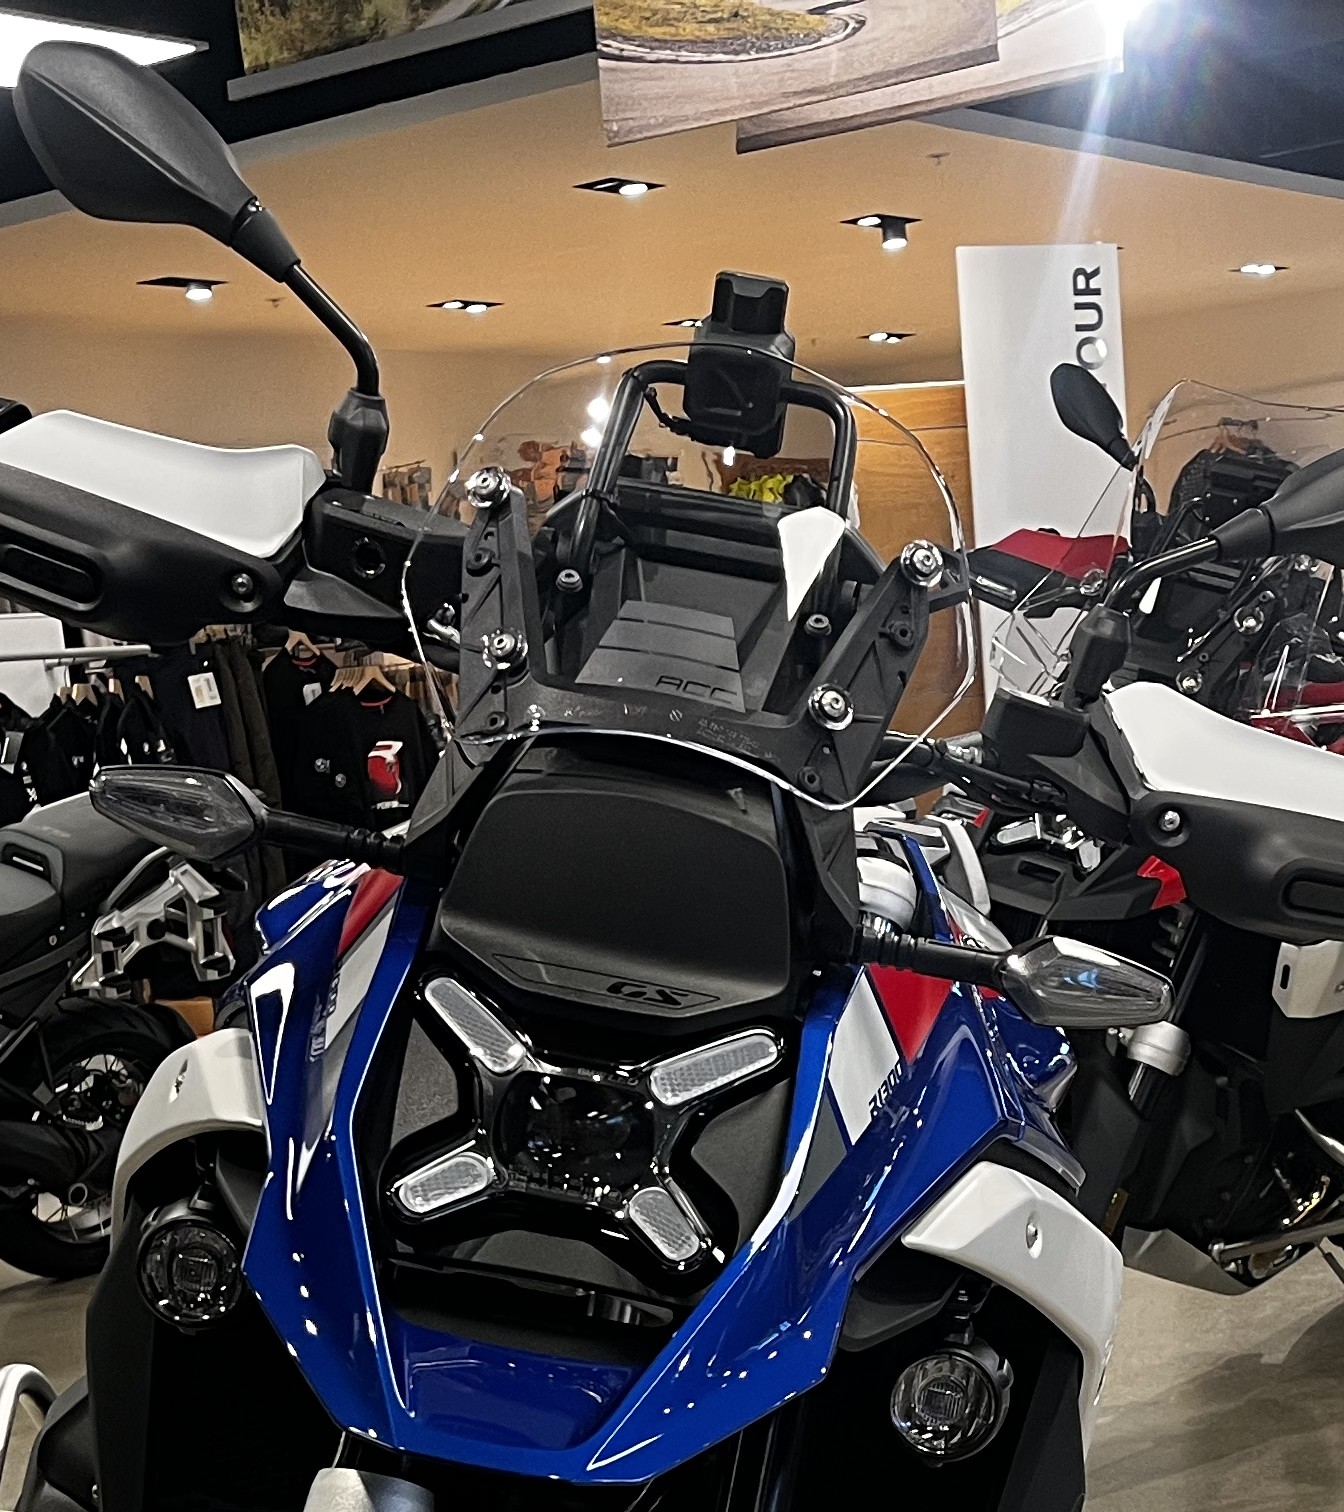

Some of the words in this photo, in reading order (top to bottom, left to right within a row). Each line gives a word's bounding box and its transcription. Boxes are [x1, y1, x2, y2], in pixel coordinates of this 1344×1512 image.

[1072, 265, 1108, 388] OUR
[655, 674, 738, 705] ACC
[606, 981, 690, 1006] GS
